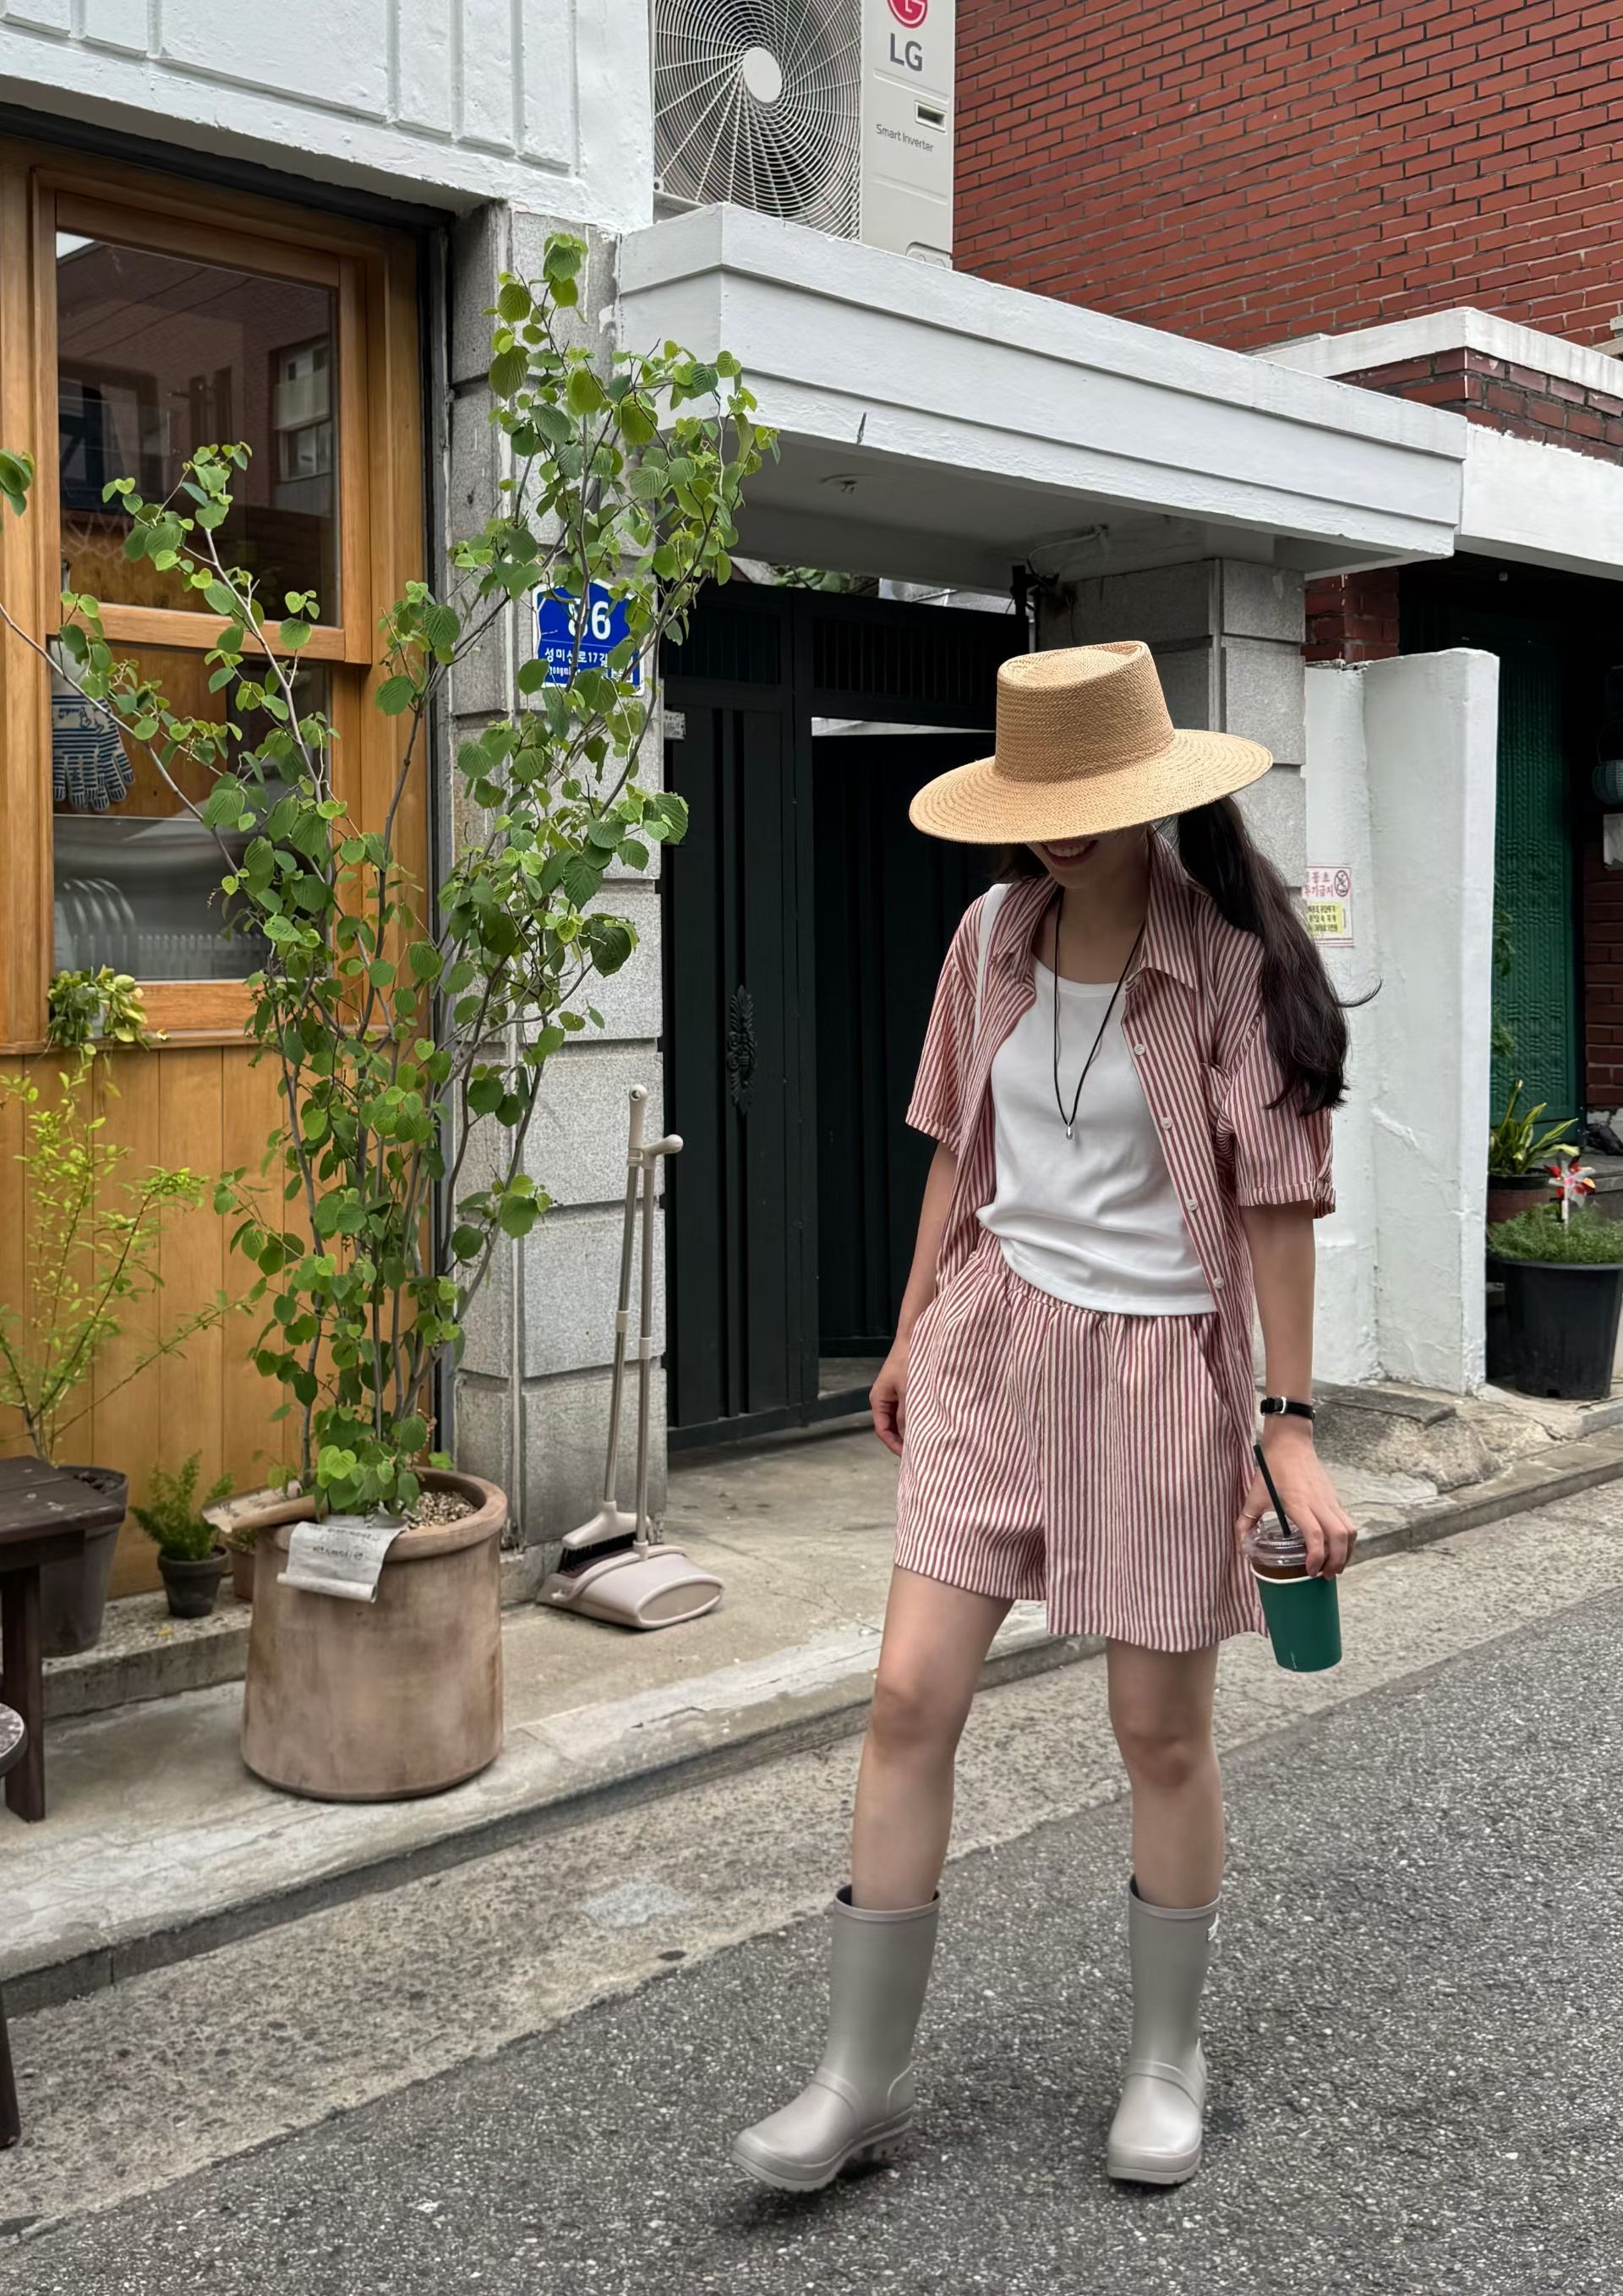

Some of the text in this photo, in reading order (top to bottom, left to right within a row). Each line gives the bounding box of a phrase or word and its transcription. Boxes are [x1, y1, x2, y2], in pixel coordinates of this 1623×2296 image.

[890, 32, 922, 72] LG
[876, 123, 934, 153] Smart Inverter
